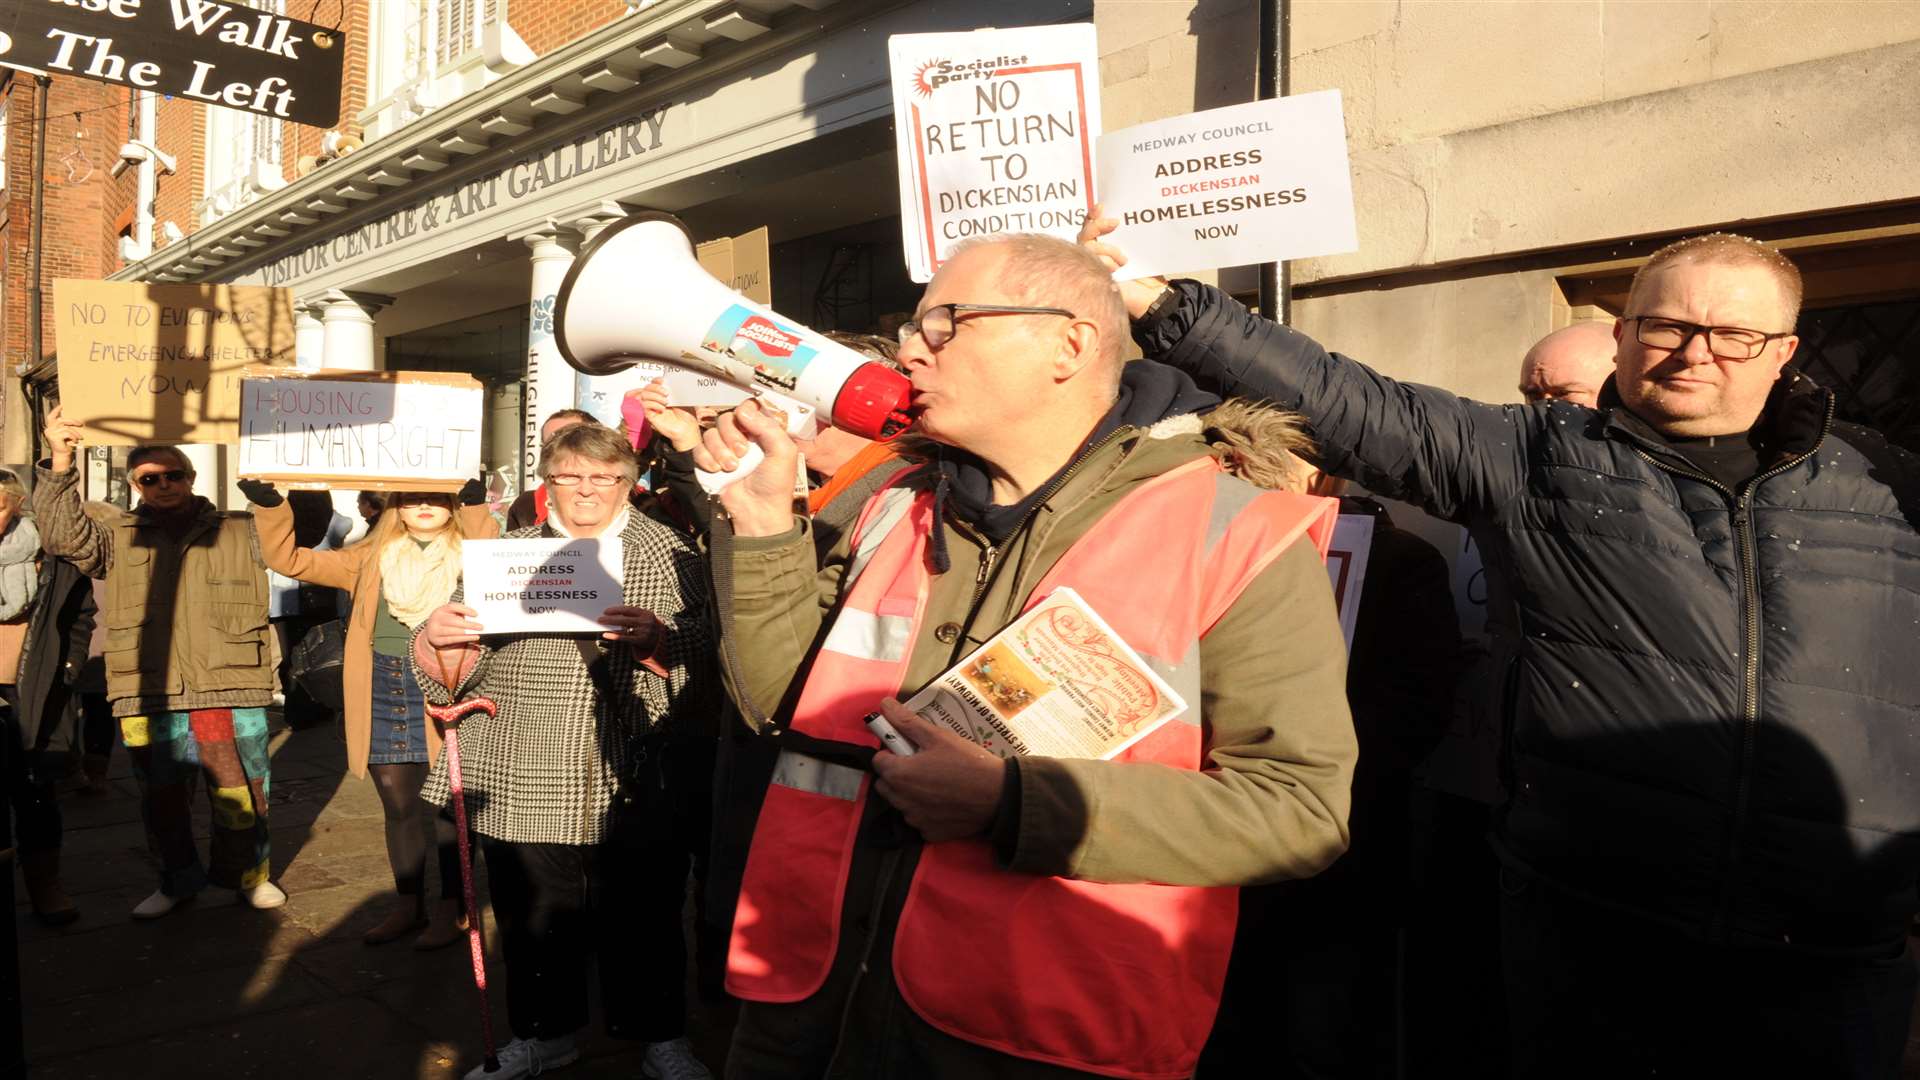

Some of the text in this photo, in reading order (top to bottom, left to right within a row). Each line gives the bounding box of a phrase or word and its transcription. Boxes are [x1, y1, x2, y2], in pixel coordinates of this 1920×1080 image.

[169, 0, 303, 60] Walk
[46, 28, 161, 87] The
[183, 60, 296, 117] Left
[931, 67, 995, 89] Party
[938, 55, 1029, 74] Socialist
[976, 80, 1020, 115] NO
[927, 110, 1074, 154] RETURN
[1133, 121, 1274, 153] MEDWAY COUNCIL
[981, 154, 1028, 182] TO
[1154, 149, 1262, 178] ADDRESS
[261, 104, 672, 287] VISITOR CENTRE & ART GALLERY
[939, 179, 1077, 213] DICKENSIAN
[1161, 174, 1260, 197] DICKENSIAN
[1123, 188, 1307, 227] HOMELESSNESS
[943, 208, 1085, 240] CONDITIONS
[1194, 223, 1239, 242] NOW
[71, 303, 255, 327] NO TO EVICTIONS
[747, 322, 777, 336] JOIN
[121, 374, 210, 398] NOW
[697, 378, 718, 387] NOW
[256, 388, 373, 415] HOUSING
[248, 420, 476, 470] HUMAN RIGHT
[540, 550, 583, 558] COUNCIL
[507, 565, 575, 575] ADDRESS
[511, 579, 572, 587] DICKENSIAN
[484, 590, 598, 601] HOMELESSNESS
[528, 606, 557, 615] NOW
[945, 673, 981, 709] MEDWAY!
[1109, 676, 1138, 704] Public
[1112, 663, 1148, 698] Meeting
[976, 703, 990, 718] OF
[985, 712, 1018, 745] STREETS
